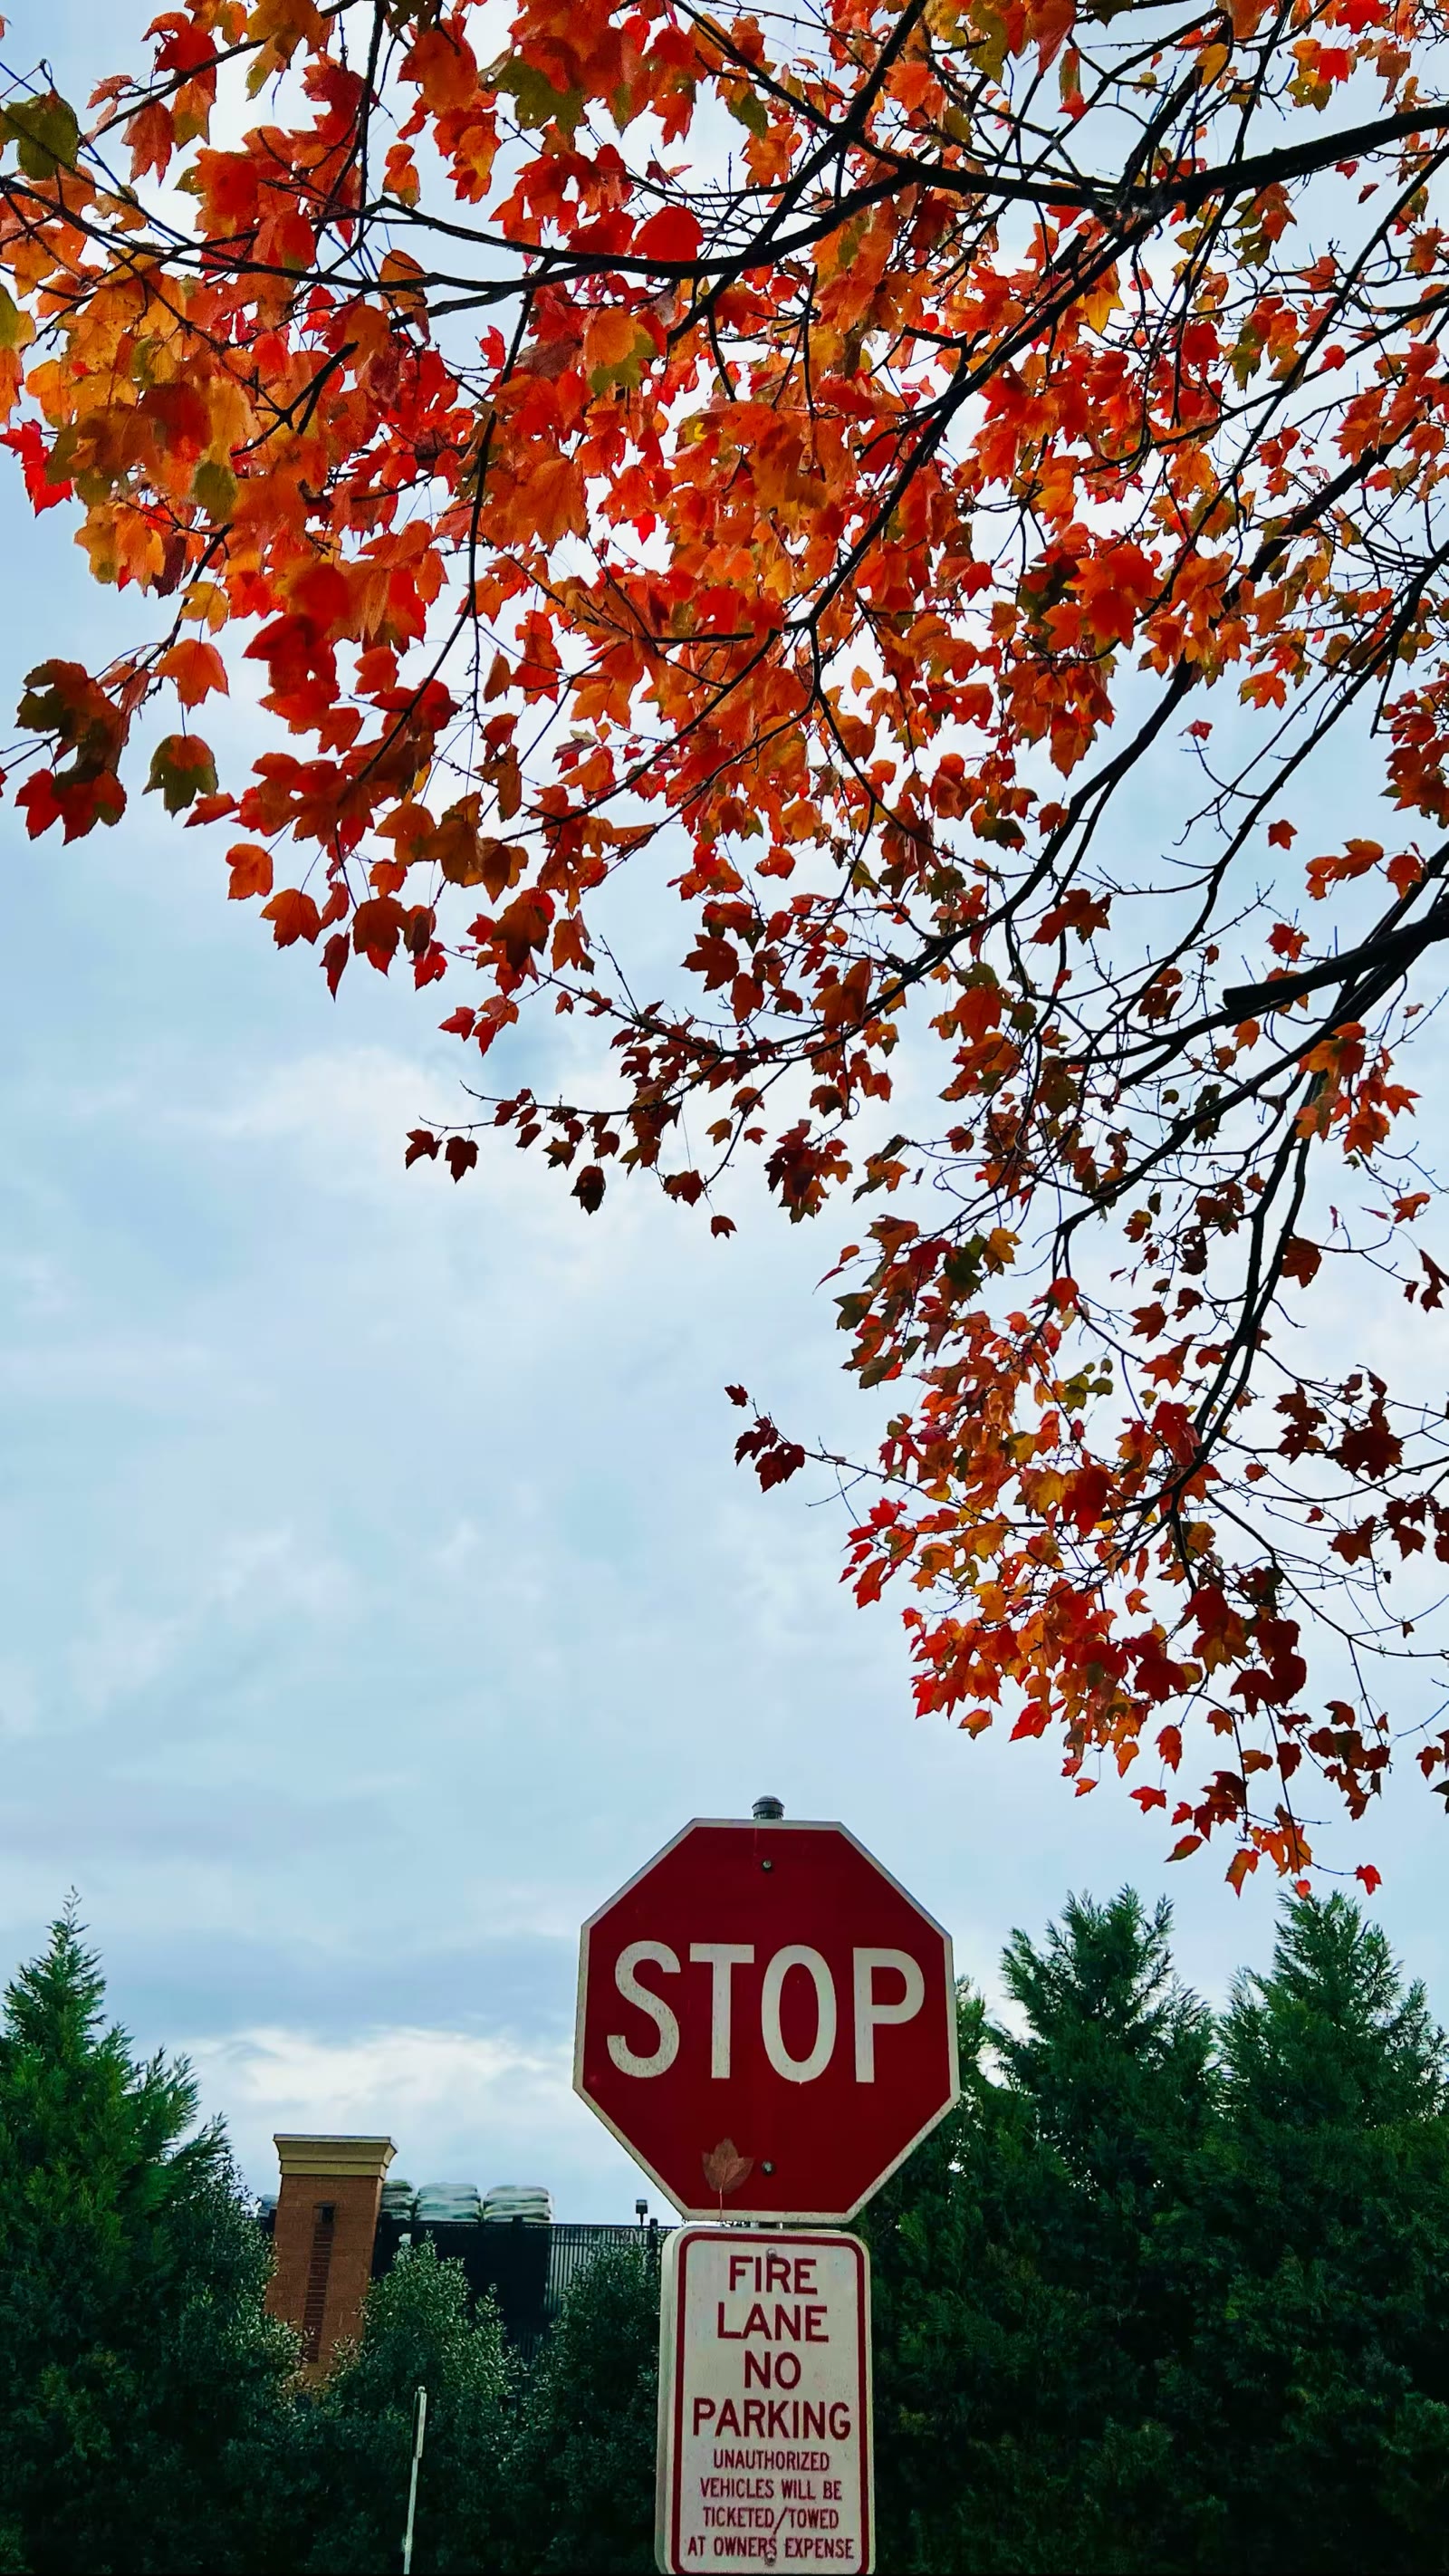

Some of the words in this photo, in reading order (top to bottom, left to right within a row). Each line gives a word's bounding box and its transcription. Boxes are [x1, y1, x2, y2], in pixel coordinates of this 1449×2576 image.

[607, 1940, 925, 2083] STOP
[728, 2254, 818, 2295] FIRE
[716, 2302, 830, 2343] LANE
[744, 2350, 801, 2390] NO
[693, 2398, 851, 2440] PARKING
[713, 2448, 830, 2472] UNAUTHORIZED
[700, 2477, 774, 2498] VEHICLES
[781, 2479, 816, 2500] WILL
[822, 2480, 842, 2501] BE
[703, 2506, 840, 2534] TICKETED/TOWED
[687, 2537, 705, 2557] AT
[714, 2537, 777, 2559] OWNERS
[784, 2539, 855, 2560] EXPENSE
